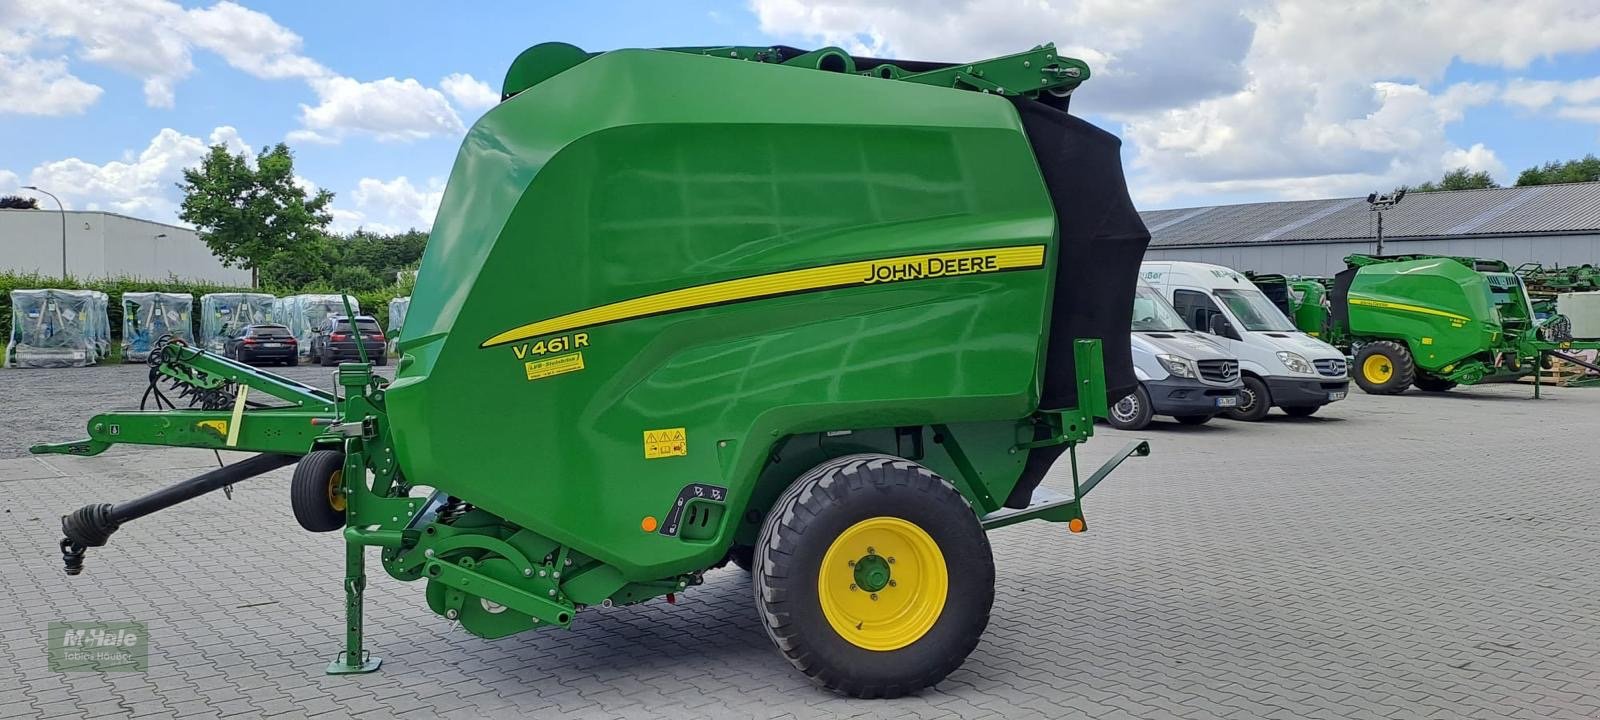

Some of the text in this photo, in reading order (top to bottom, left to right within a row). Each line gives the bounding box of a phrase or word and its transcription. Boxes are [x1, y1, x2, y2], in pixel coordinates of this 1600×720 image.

[864, 256, 997, 281] JOHN DEERE
[512, 333, 589, 360] V 461 R
